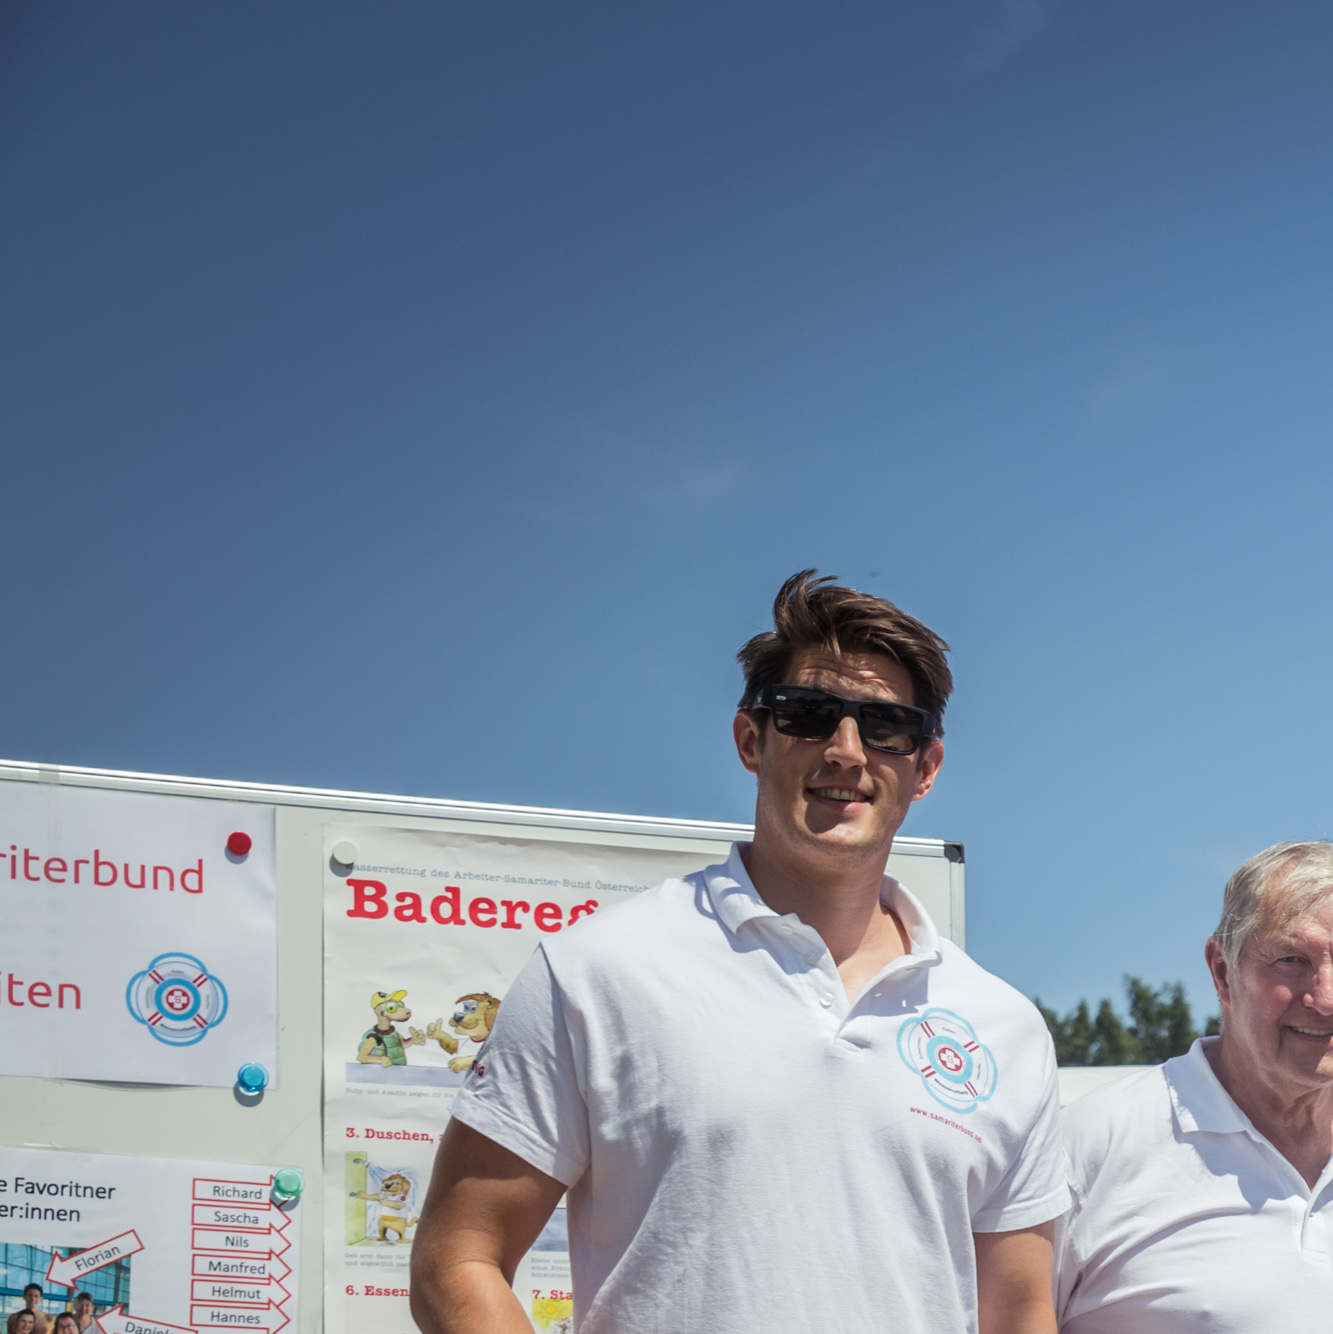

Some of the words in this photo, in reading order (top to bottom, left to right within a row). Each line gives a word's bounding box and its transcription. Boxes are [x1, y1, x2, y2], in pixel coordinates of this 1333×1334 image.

[431, 868, 449, 878] des
[0, 970, 81, 1009] ten
[345, 1127, 359, 1138] 3.
[365, 1128, 434, 1144] Duschen,
[15, 1177, 116, 1199] Favoritner
[213, 1186, 262, 1200] Richard
[214, 1211, 259, 1225] Sascha
[225, 1236, 249, 1248] Nils
[75, 1246, 121, 1271] Florian
[208, 1261, 266, 1275] Manfred
[212, 1286, 261, 1300] Helmut
[345, 1285, 359, 1296] 6.
[364, 1285, 411, 1297] Essen
[531, 1289, 545, 1300] 7.
[211, 1312, 261, 1325] Hannes
